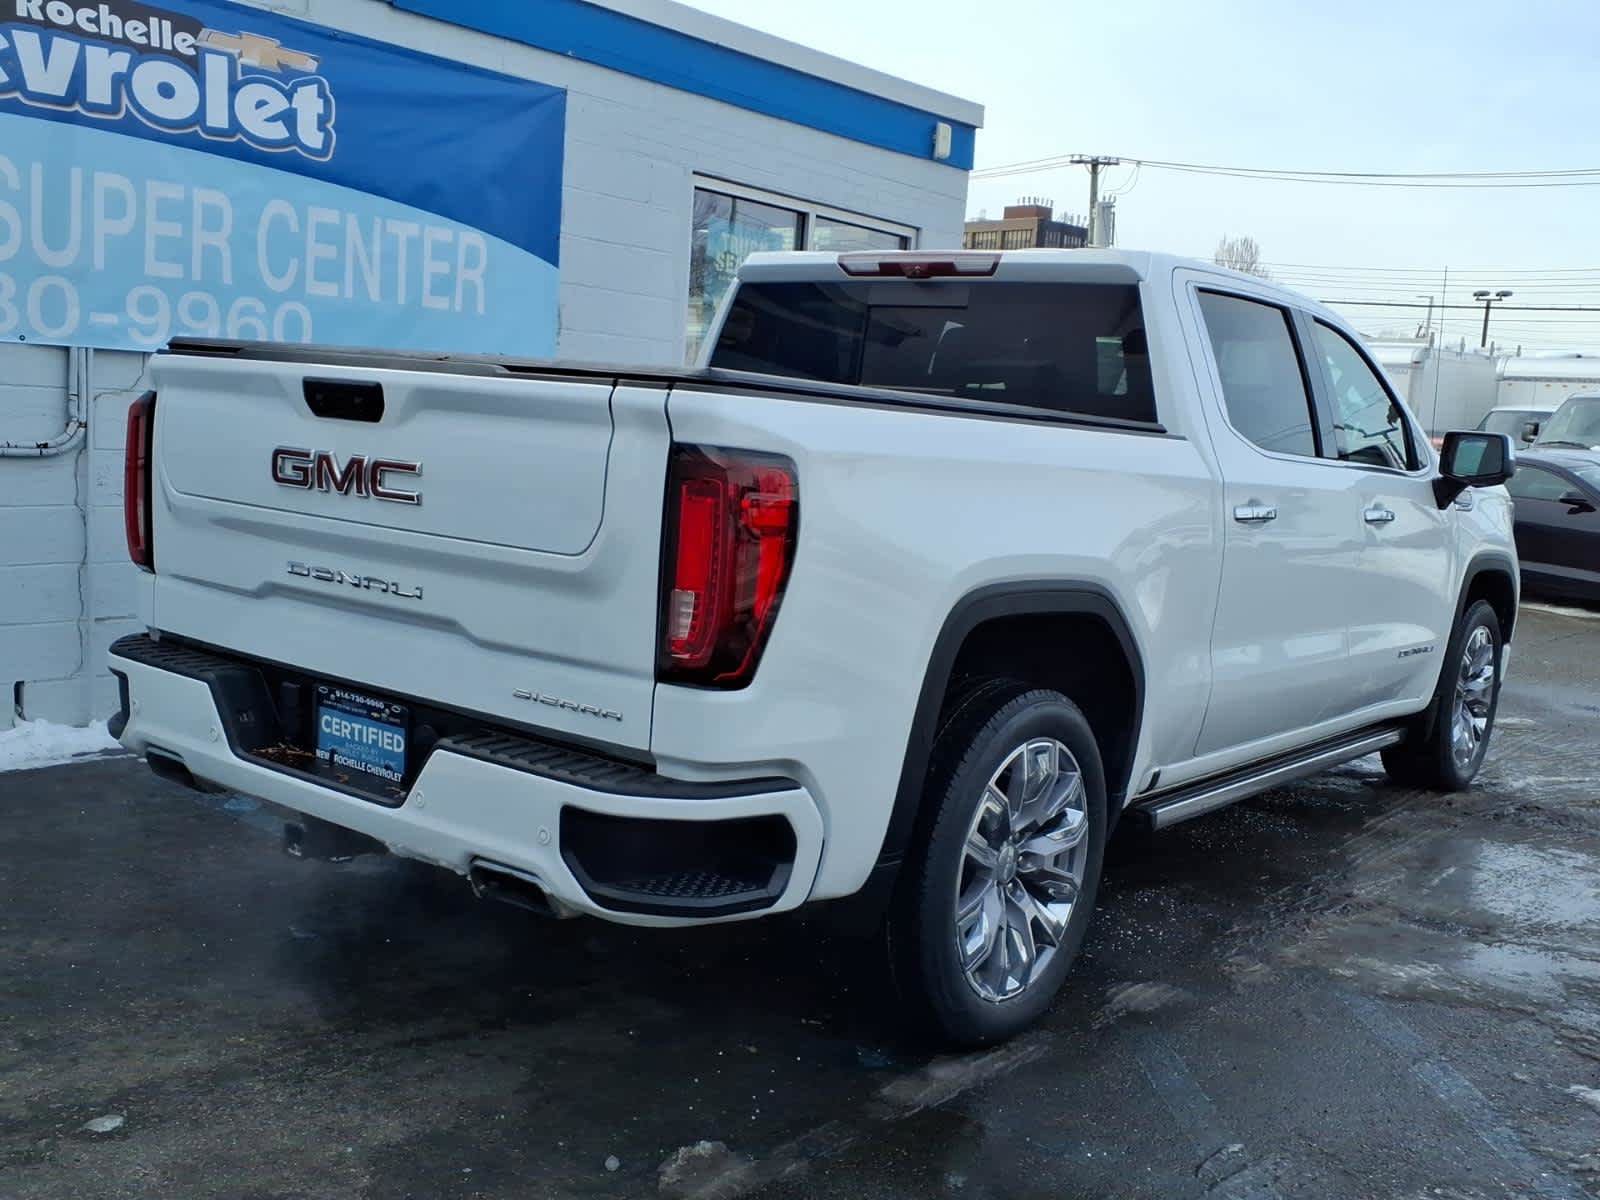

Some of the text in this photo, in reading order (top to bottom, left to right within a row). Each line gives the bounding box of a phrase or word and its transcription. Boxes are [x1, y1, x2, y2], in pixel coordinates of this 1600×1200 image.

[16, 0, 197, 56] Rochelle
[0, 28, 326, 151] vrolet
[256, 199, 488, 315] CENTER
[272, 446, 422, 506] GMC
[287, 560, 424, 601] DENALI
[512, 687, 624, 722] SIERRA
[321, 715, 405, 752] CERTIFIED
[315, 748, 331, 761] NEW
[334, 754, 366, 771] ROCHELLE
[366, 764, 402, 782] CHEVROLET
